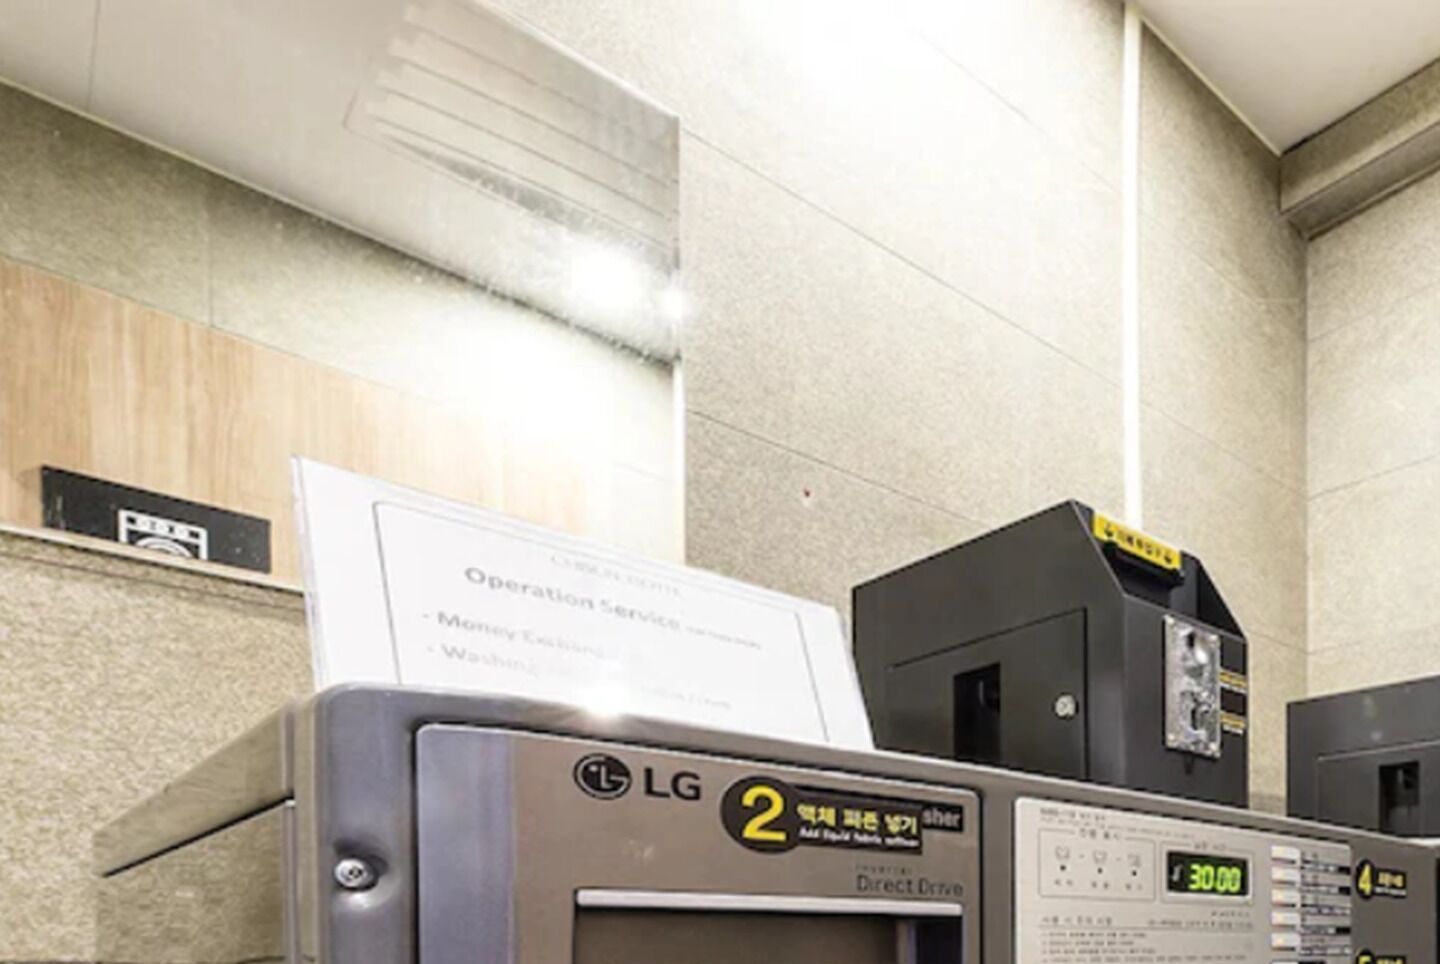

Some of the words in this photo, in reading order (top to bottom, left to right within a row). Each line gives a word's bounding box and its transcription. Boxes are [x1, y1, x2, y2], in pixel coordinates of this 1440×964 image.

[464, 566, 594, 611] Operation
[600, 600, 680, 630] Service
[437, 610, 516, 642] Money
[644, 766, 701, 801] LG
[741, 785, 787, 842] 2
[857, 874, 914, 894] Direct
[918, 878, 963, 896] Drive
[1358, 863, 1371, 896] 4
